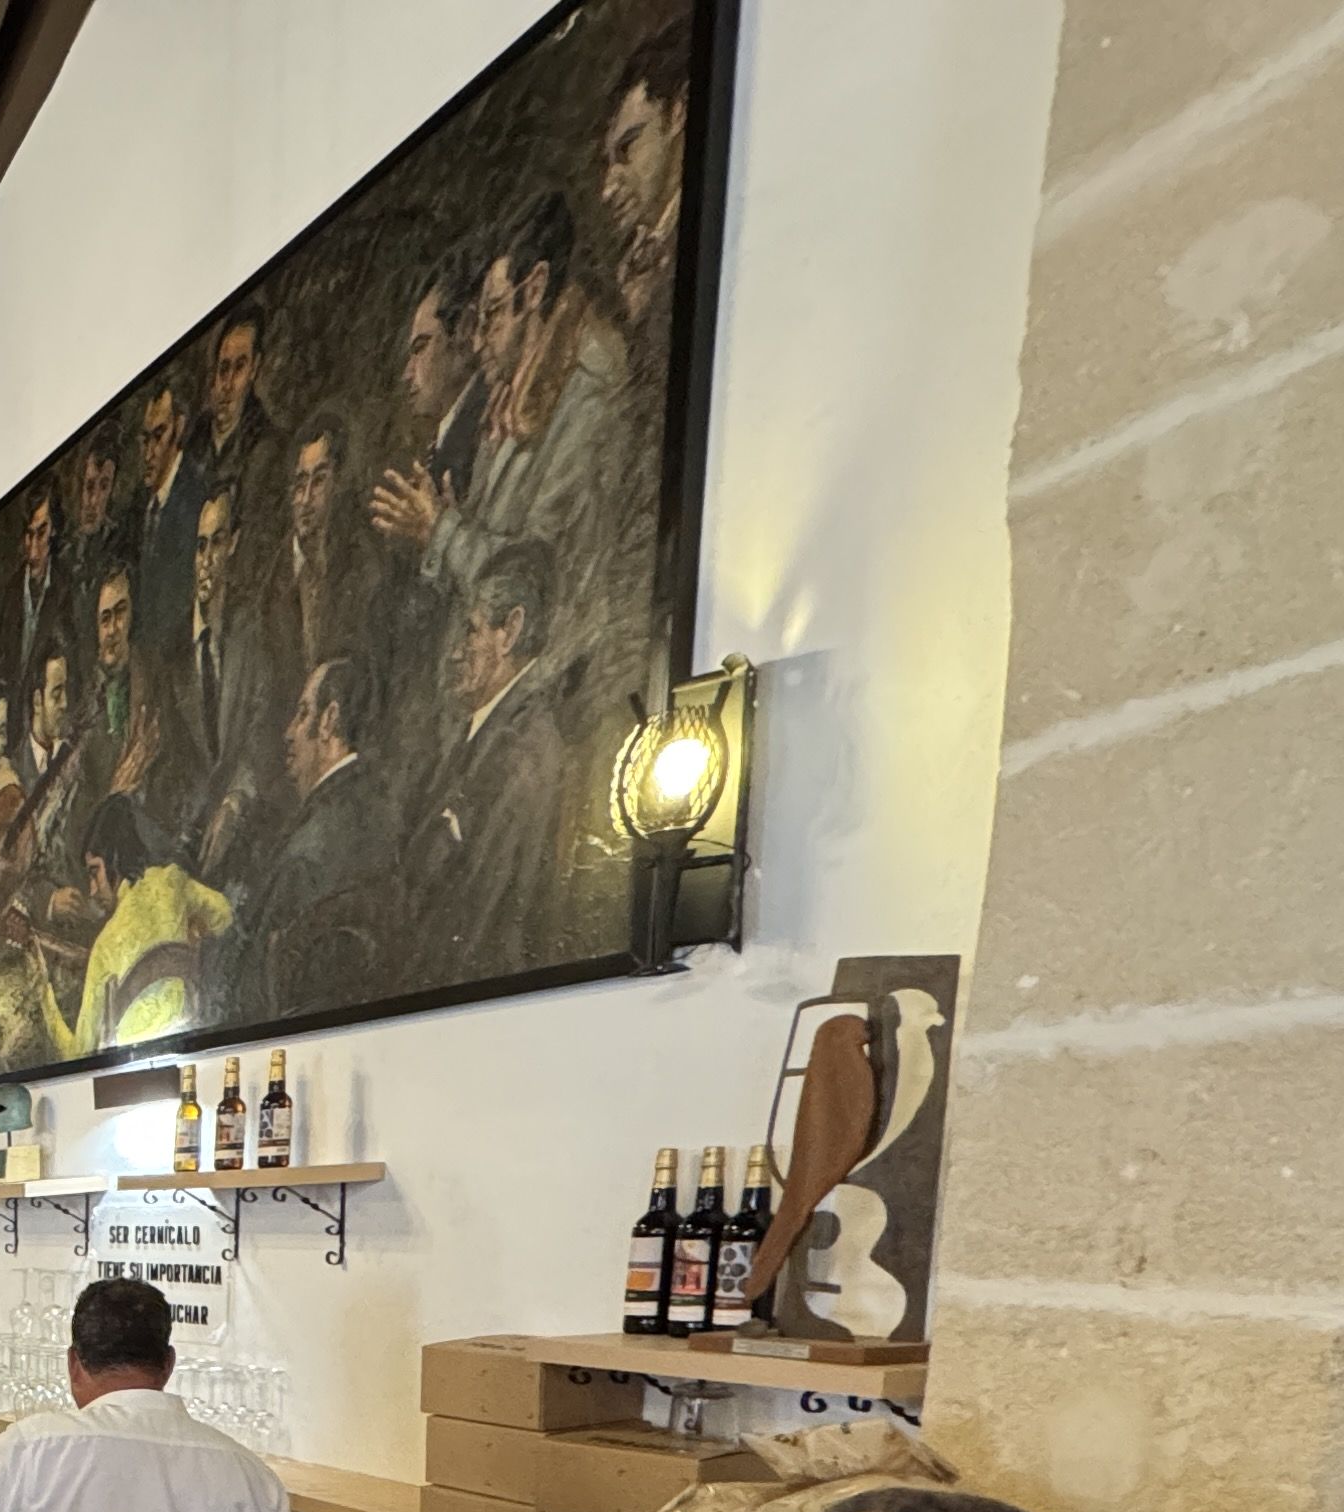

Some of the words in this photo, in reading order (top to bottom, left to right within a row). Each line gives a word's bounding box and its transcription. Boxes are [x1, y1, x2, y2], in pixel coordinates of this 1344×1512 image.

[109, 1226, 129, 1244] SER
[97, 1261, 126, 1278] TIENE
[129, 1262, 143, 1281] SU
[147, 1263, 222, 1285] IMPORTANCIA
[169, 1305, 208, 1325] UCHAR
